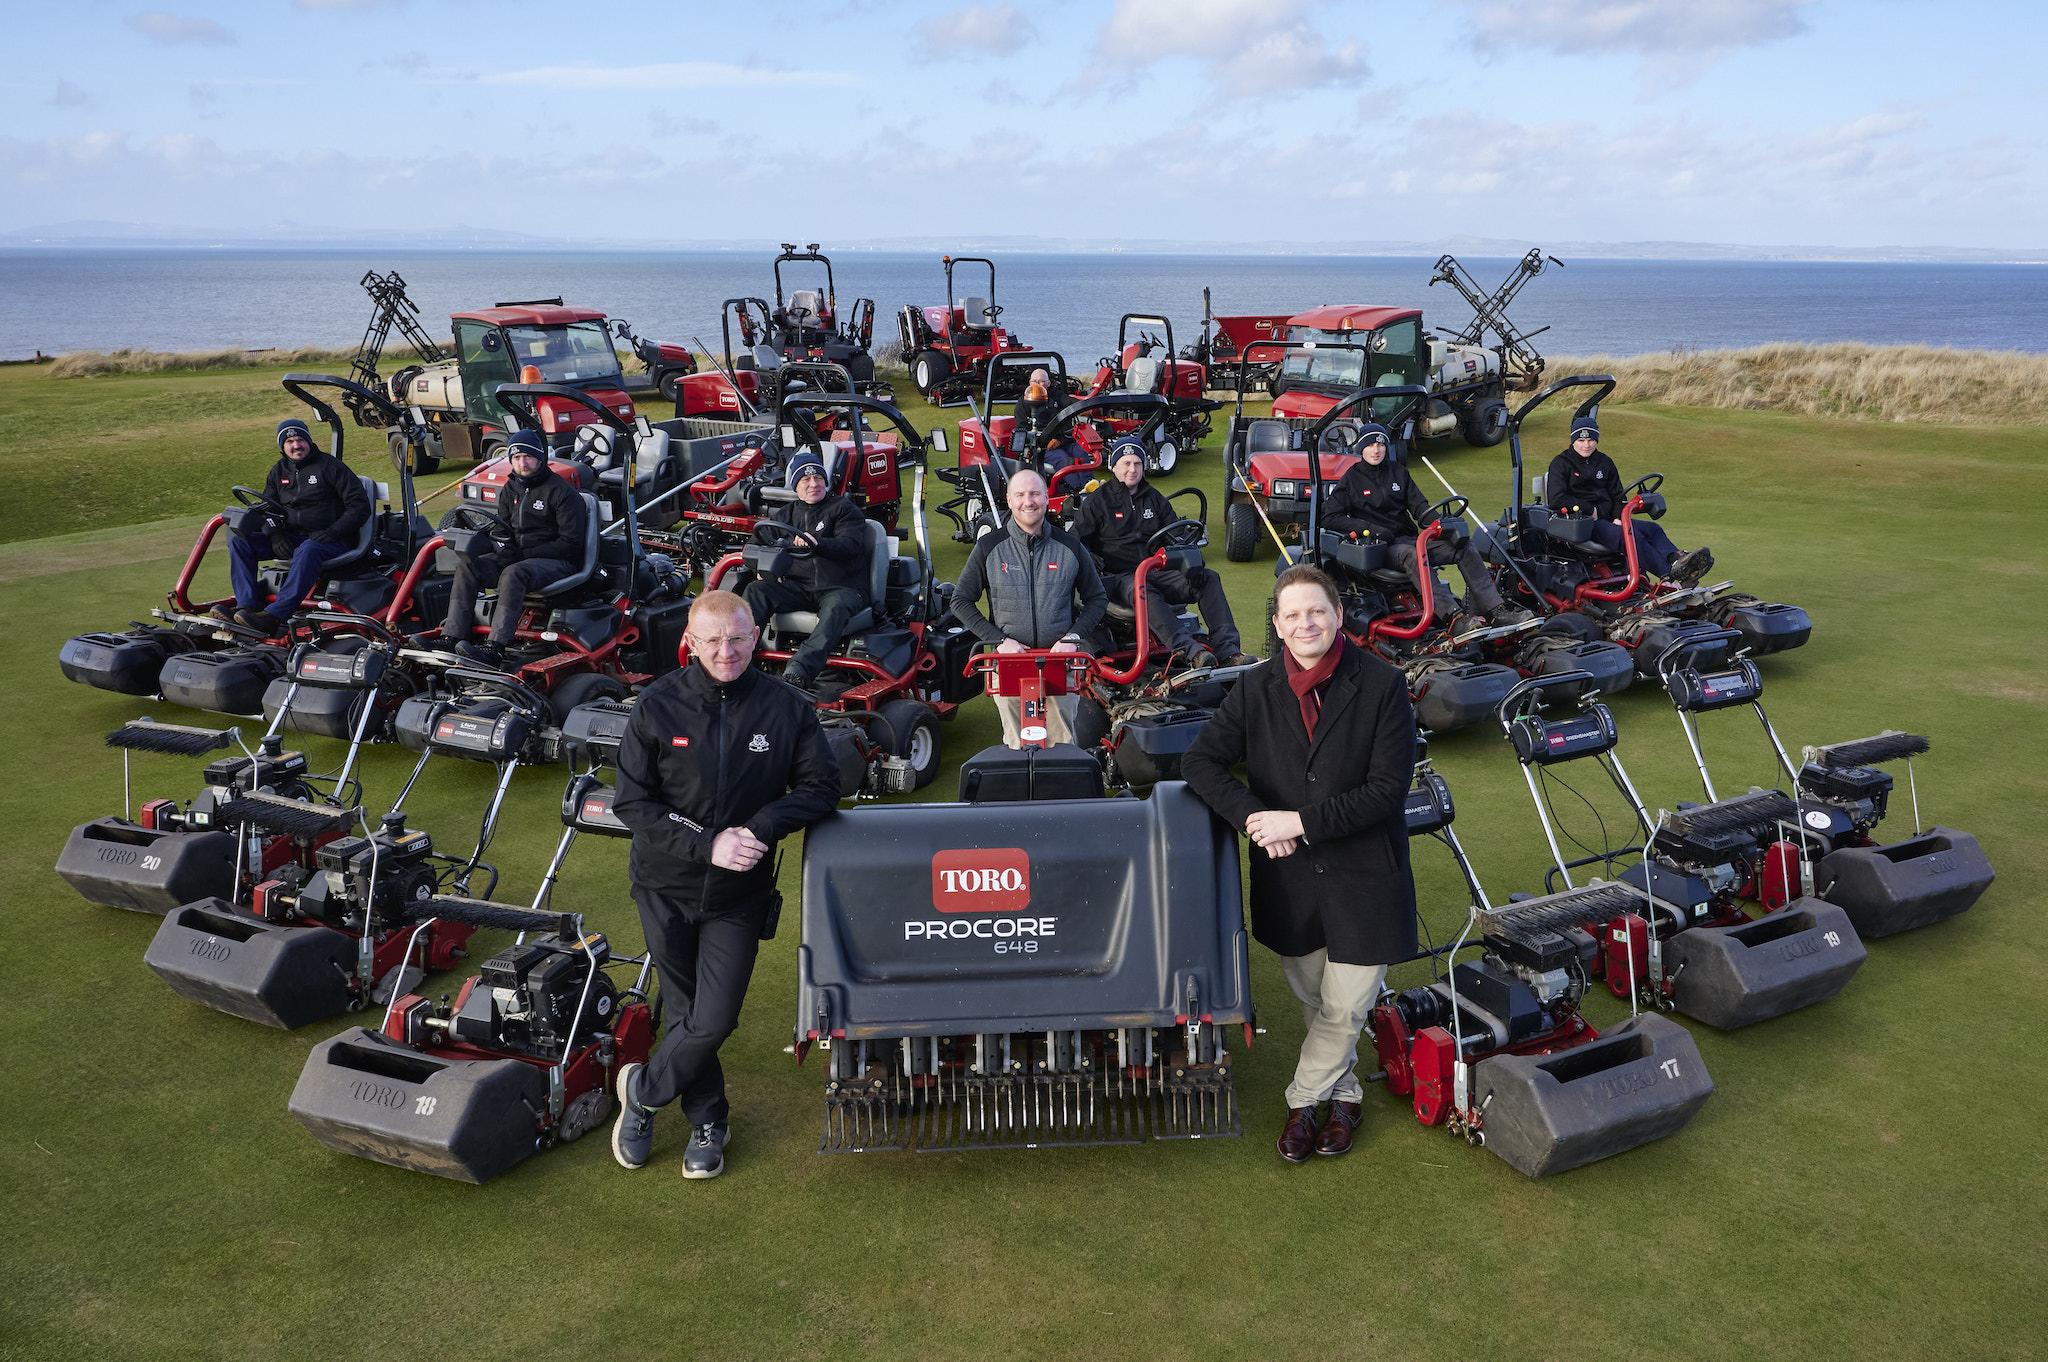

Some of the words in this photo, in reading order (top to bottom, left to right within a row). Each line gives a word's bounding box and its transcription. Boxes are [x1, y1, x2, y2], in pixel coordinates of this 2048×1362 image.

[870, 459, 886, 469] TORO
[440, 726, 454, 734] TORO
[454, 730, 490, 740] GREENSMASTER
[1565, 730, 1600, 741] GREENSMASTER
[585, 804, 603, 813] TORO
[97, 847, 137, 865] TORO
[140, 855, 161, 870] 20
[940, 867, 1023, 892] TORO
[904, 917, 1057, 940] PROCORE
[189, 938, 232, 963] TORO
[993, 940, 1039, 954] 648
[1779, 936, 1822, 961] TORO
[1823, 931, 1841, 948] 19
[1600, 1067, 1657, 1099] TORO
[1659, 1058, 1680, 1080] 17
[350, 1080, 406, 1109] TORO
[415, 1095, 437, 1116] 18
